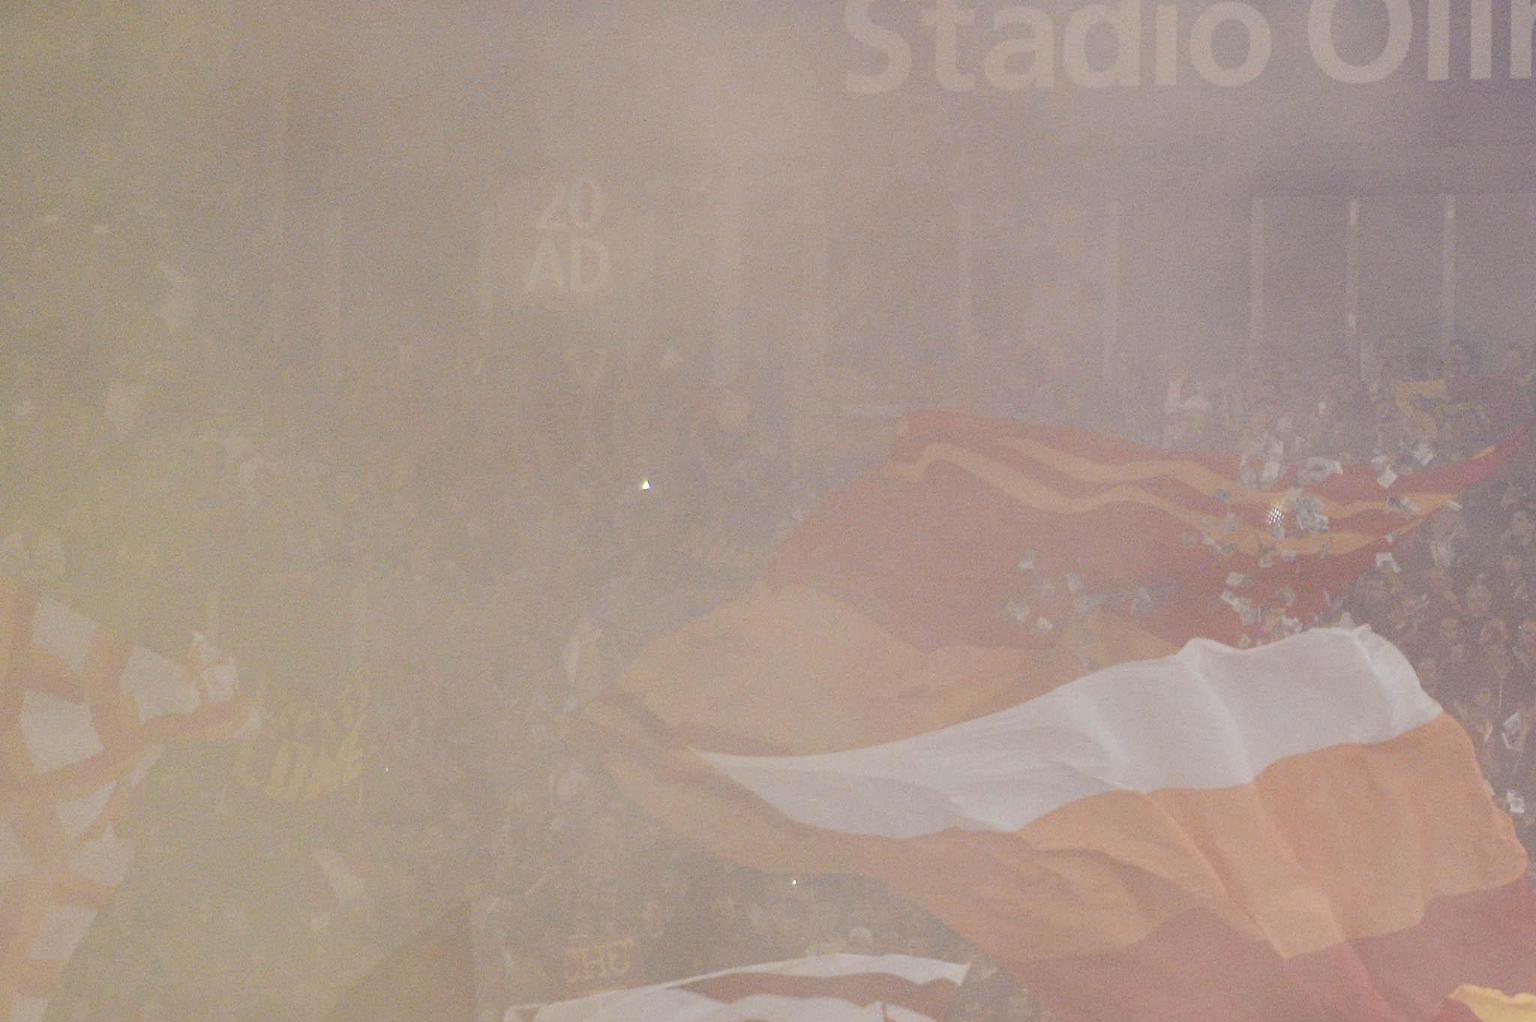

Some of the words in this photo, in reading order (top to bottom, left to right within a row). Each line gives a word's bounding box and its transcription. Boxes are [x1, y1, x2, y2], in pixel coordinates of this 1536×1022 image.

[841, 0, 1272, 95] Stadio
[535, 176, 605, 230] 20
[523, 238, 611, 294] AD
